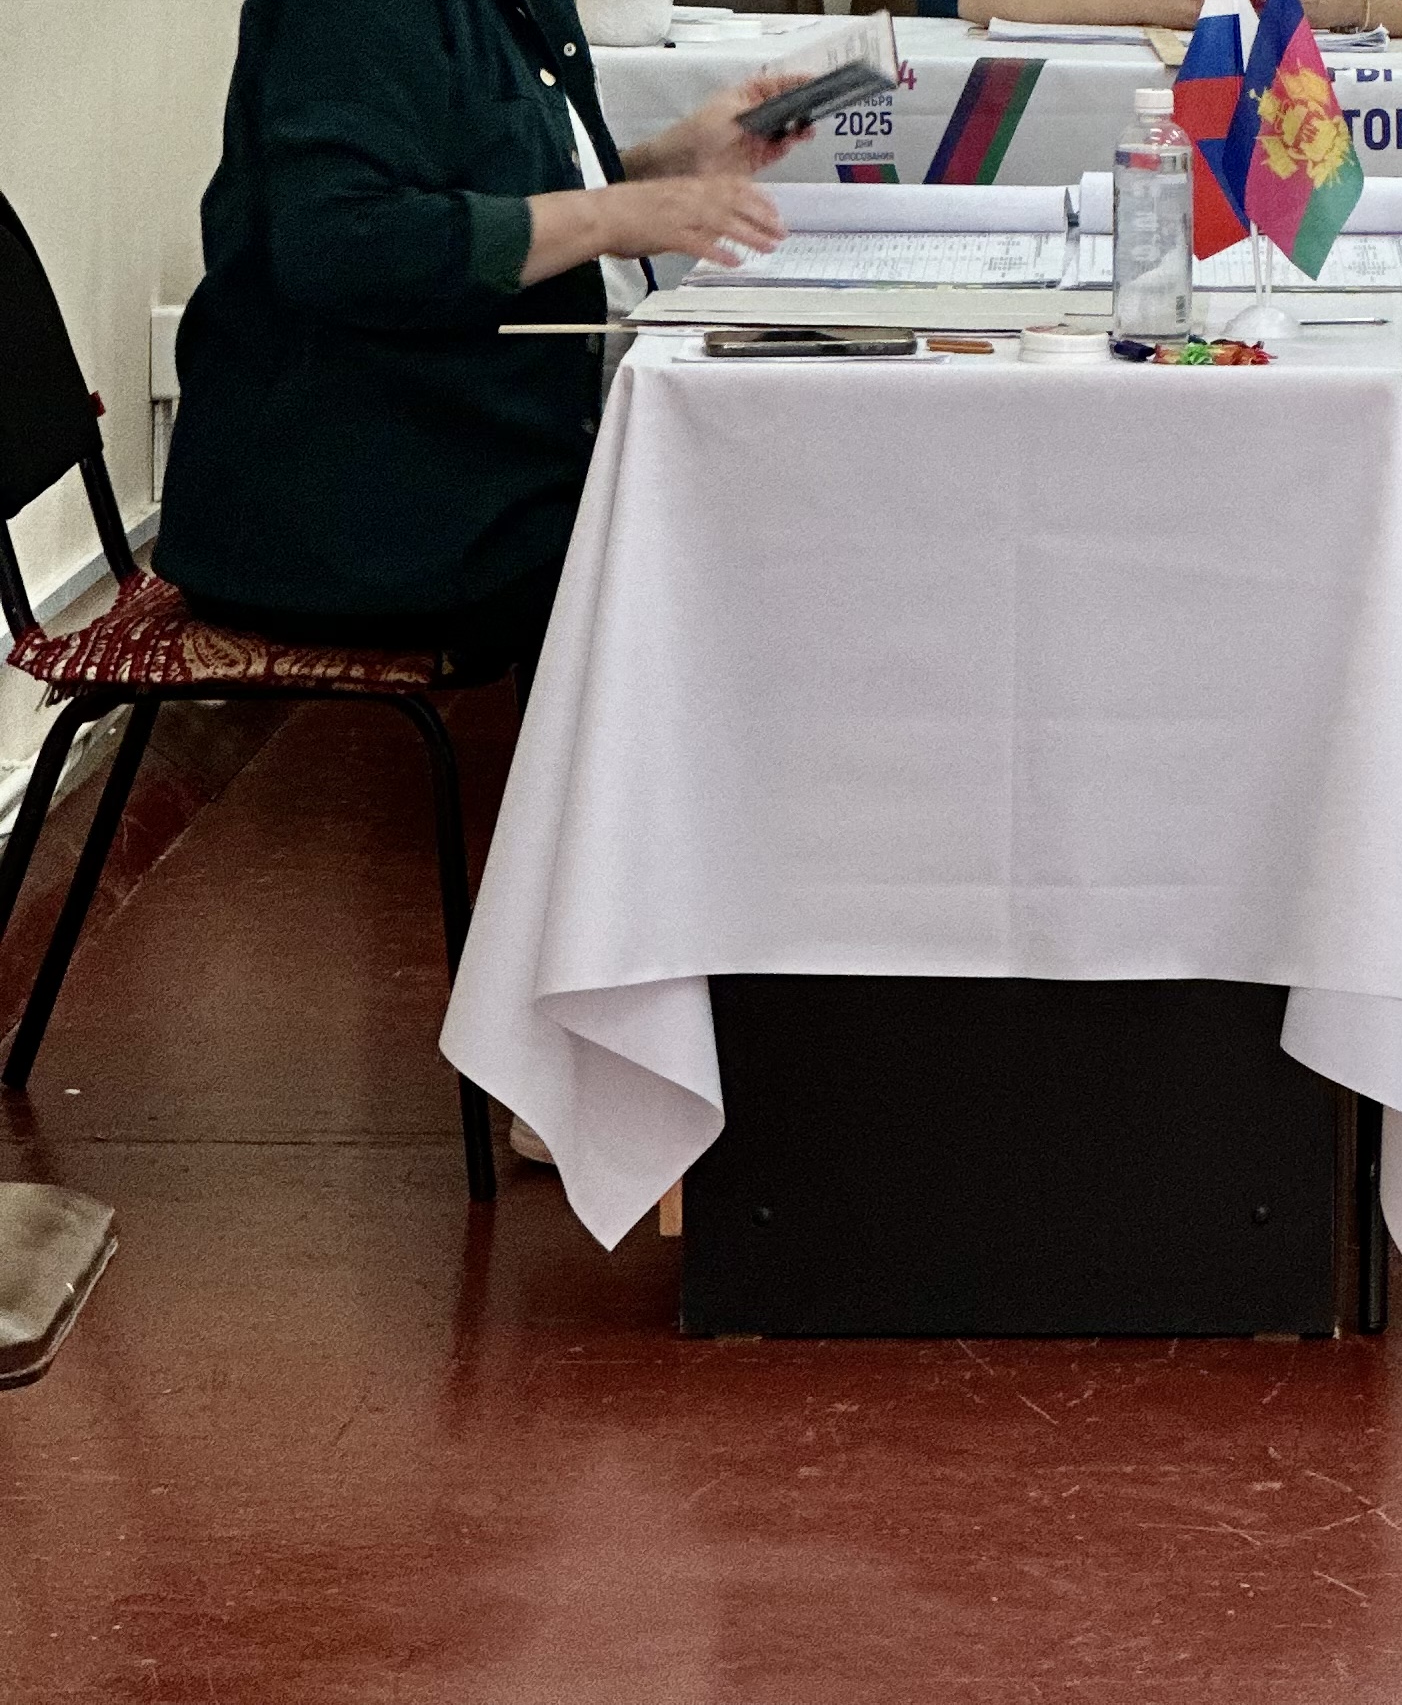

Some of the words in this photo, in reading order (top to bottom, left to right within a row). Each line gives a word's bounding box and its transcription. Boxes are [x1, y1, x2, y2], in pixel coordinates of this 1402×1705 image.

[834, 112, 892, 136] 2025
[854, 139, 873, 149] ДНИ
[834, 152, 894, 161] ГОЛОСОВАНИЯ
